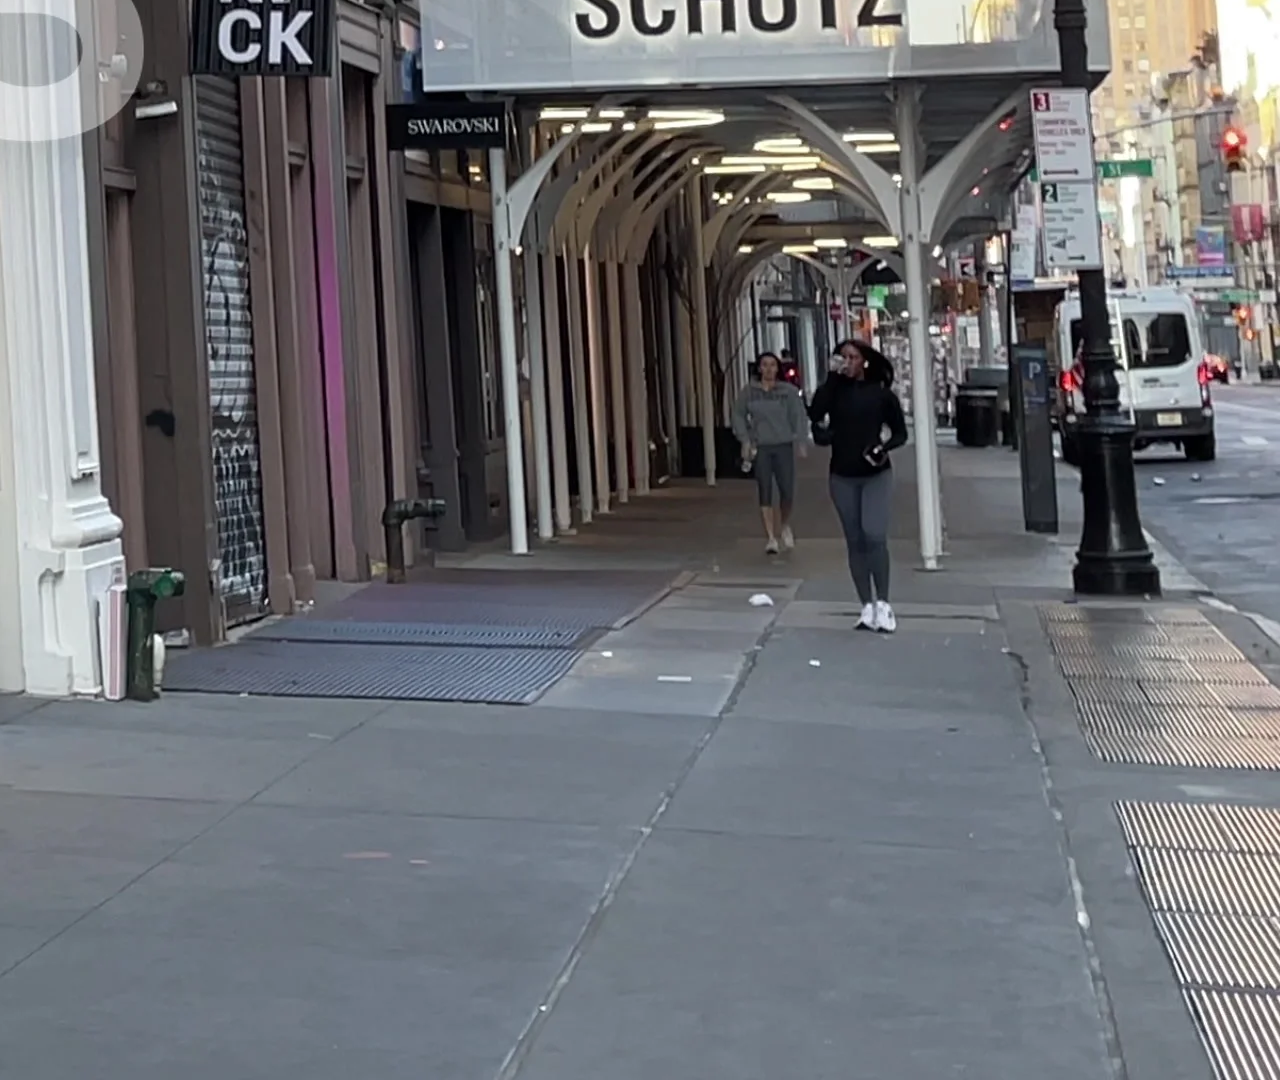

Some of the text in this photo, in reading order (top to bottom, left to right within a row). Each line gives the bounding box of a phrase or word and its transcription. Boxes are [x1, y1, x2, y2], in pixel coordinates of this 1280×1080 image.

[218, 9, 313, 65] CK
[1037, 94, 1046, 110] 3
[407, 118, 499, 136] SWAROVSKI
[1044, 185, 1054, 202] 2
[1029, 362, 1041, 379] P
